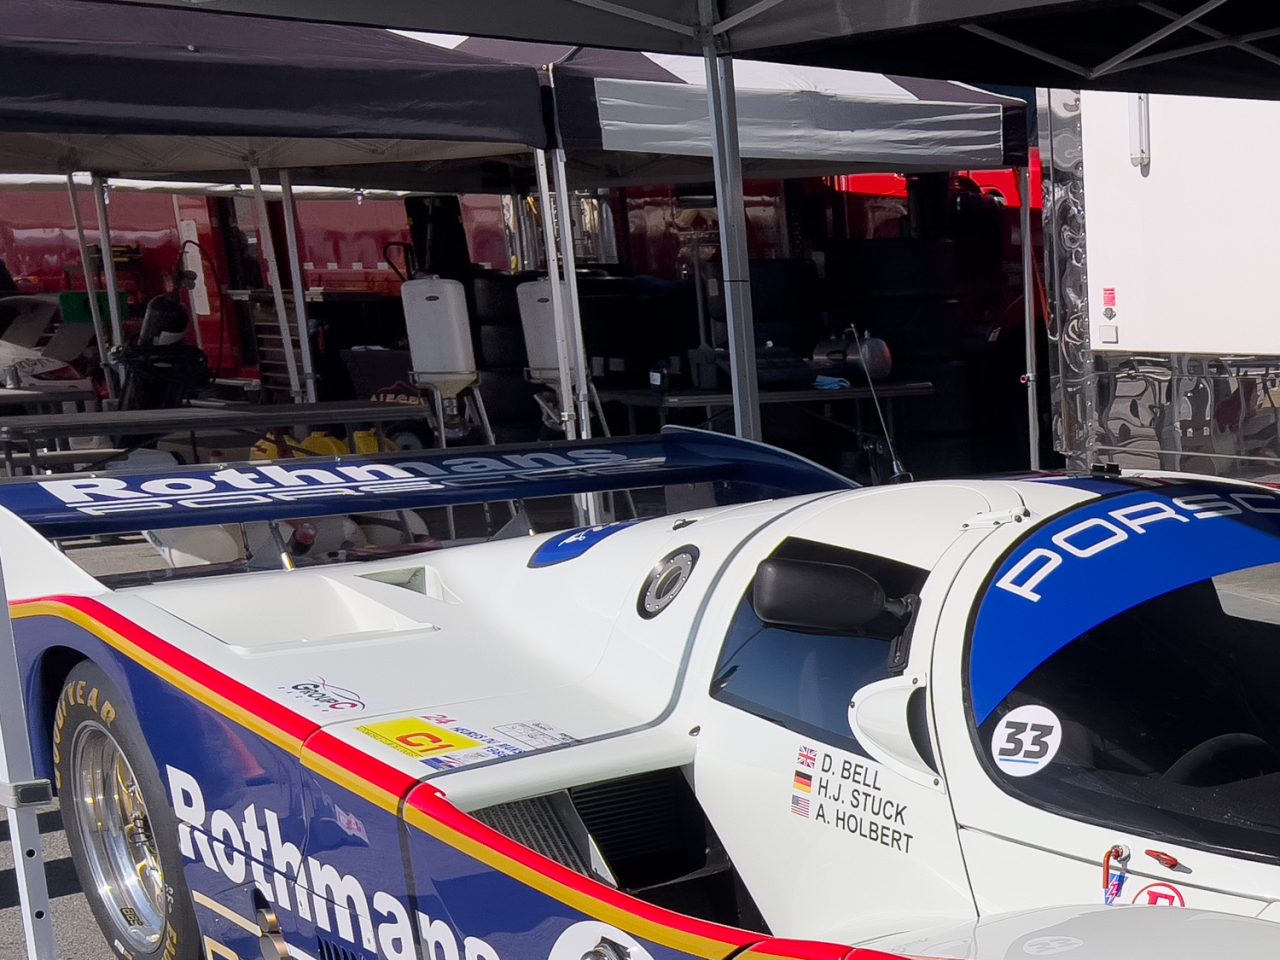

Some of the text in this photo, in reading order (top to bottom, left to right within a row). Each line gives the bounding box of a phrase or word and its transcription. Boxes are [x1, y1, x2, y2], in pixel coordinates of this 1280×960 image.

[38, 446, 628, 503] Rothmans
[395, 732, 455, 754] C1
[998, 720, 1054, 759] 33
[821, 753, 881, 791] D. BELL
[818, 777, 908, 826] H.J. STUCK
[815, 803, 914, 854] A. HOLBERT
